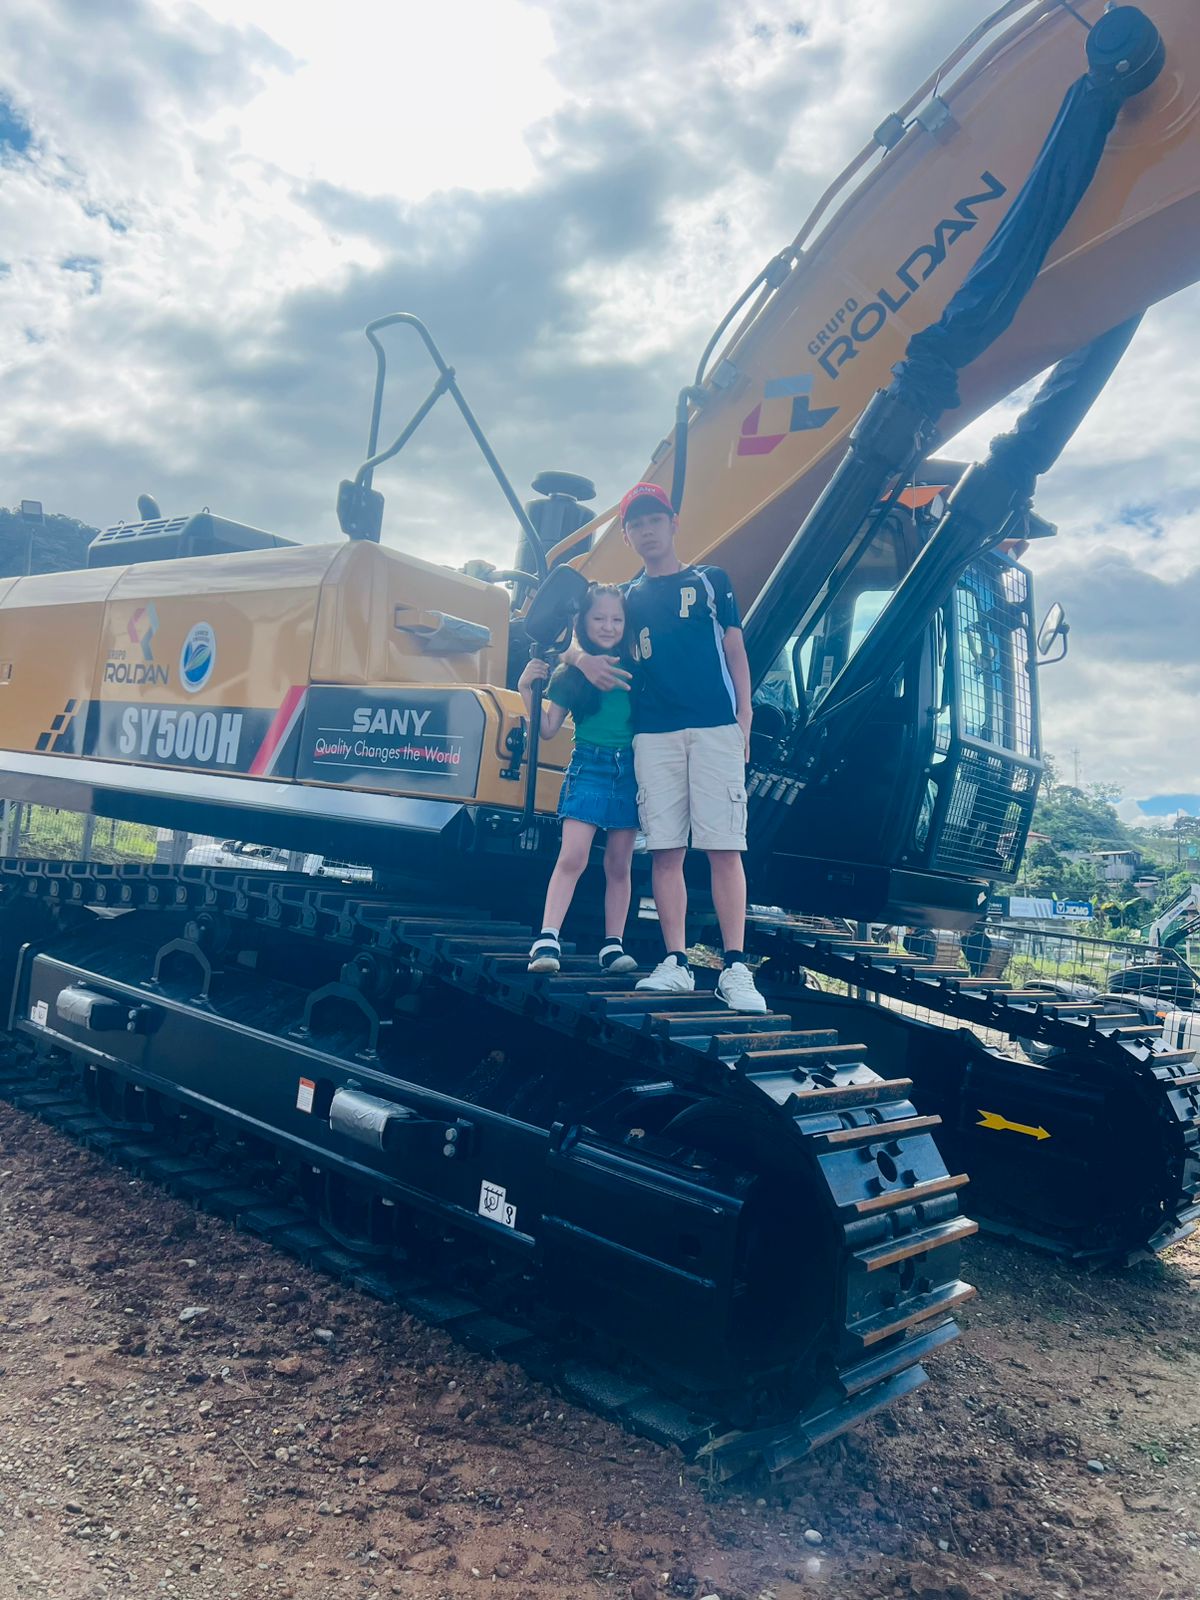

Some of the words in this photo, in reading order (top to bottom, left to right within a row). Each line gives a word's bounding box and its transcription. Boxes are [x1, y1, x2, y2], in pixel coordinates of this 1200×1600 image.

[817, 170, 1007, 380] ROLDAN
[807, 297, 858, 356] GRUPO
[679, 586, 697, 618] P
[104, 662, 169, 685] ROLDAN
[119, 706, 243, 765] SY500H
[352, 707, 432, 737] SANY
[314, 737, 352, 760] Quality
[354, 740, 401, 763] Changes
[403, 743, 420, 761] the
[424, 745, 462, 765] World
